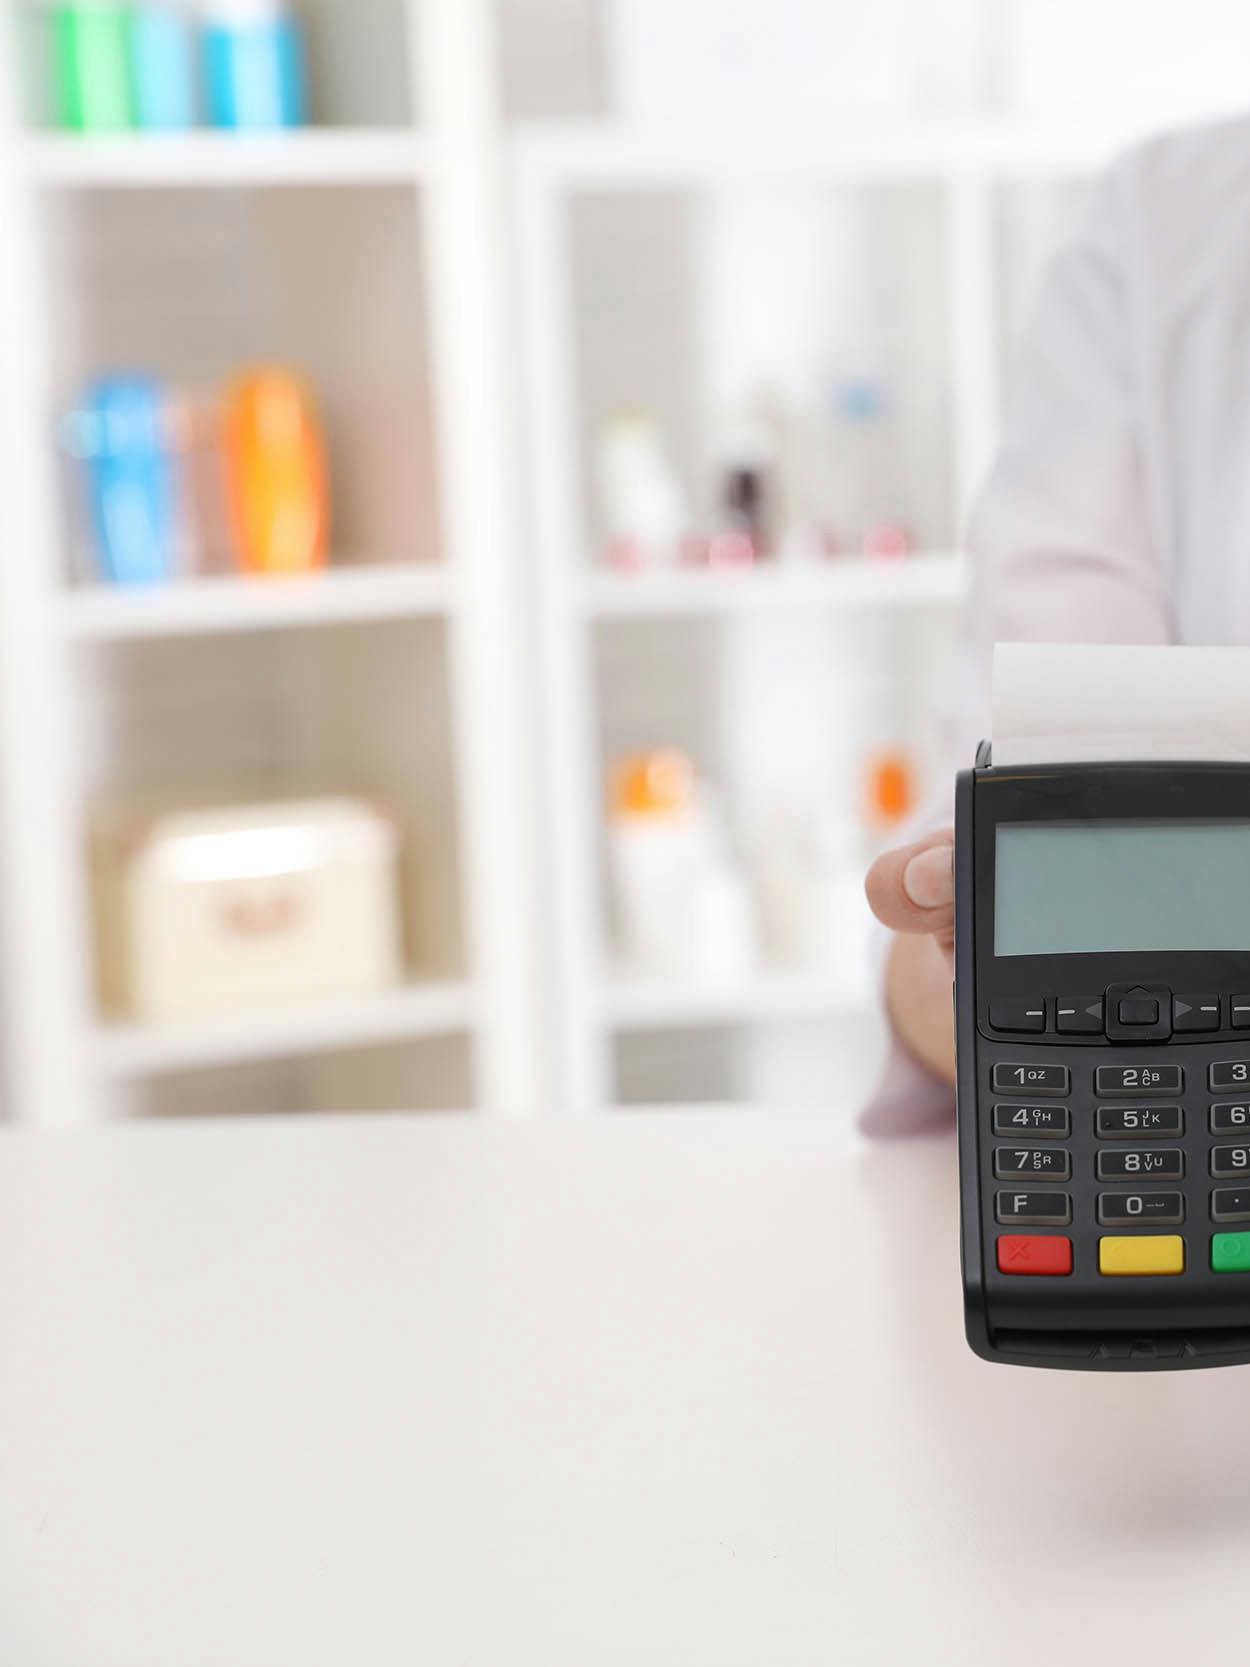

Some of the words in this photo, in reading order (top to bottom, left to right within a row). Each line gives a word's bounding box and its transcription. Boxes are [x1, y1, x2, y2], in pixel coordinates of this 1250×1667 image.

[1013, 1068, 1026, 1084] 1
[1122, 1070, 1138, 1086] 2
[1232, 1064, 1247, 1080] 3
[1012, 1109, 1028, 1125] 4
[1123, 1112, 1138, 1127] 5
[1230, 1107, 1246, 1123] 6
[1014, 1152, 1029, 1168] 7
[1124, 1154, 1140, 1170] 8
[1232, 1150, 1247, 1166] 9
[1014, 1195, 1028, 1212] F
